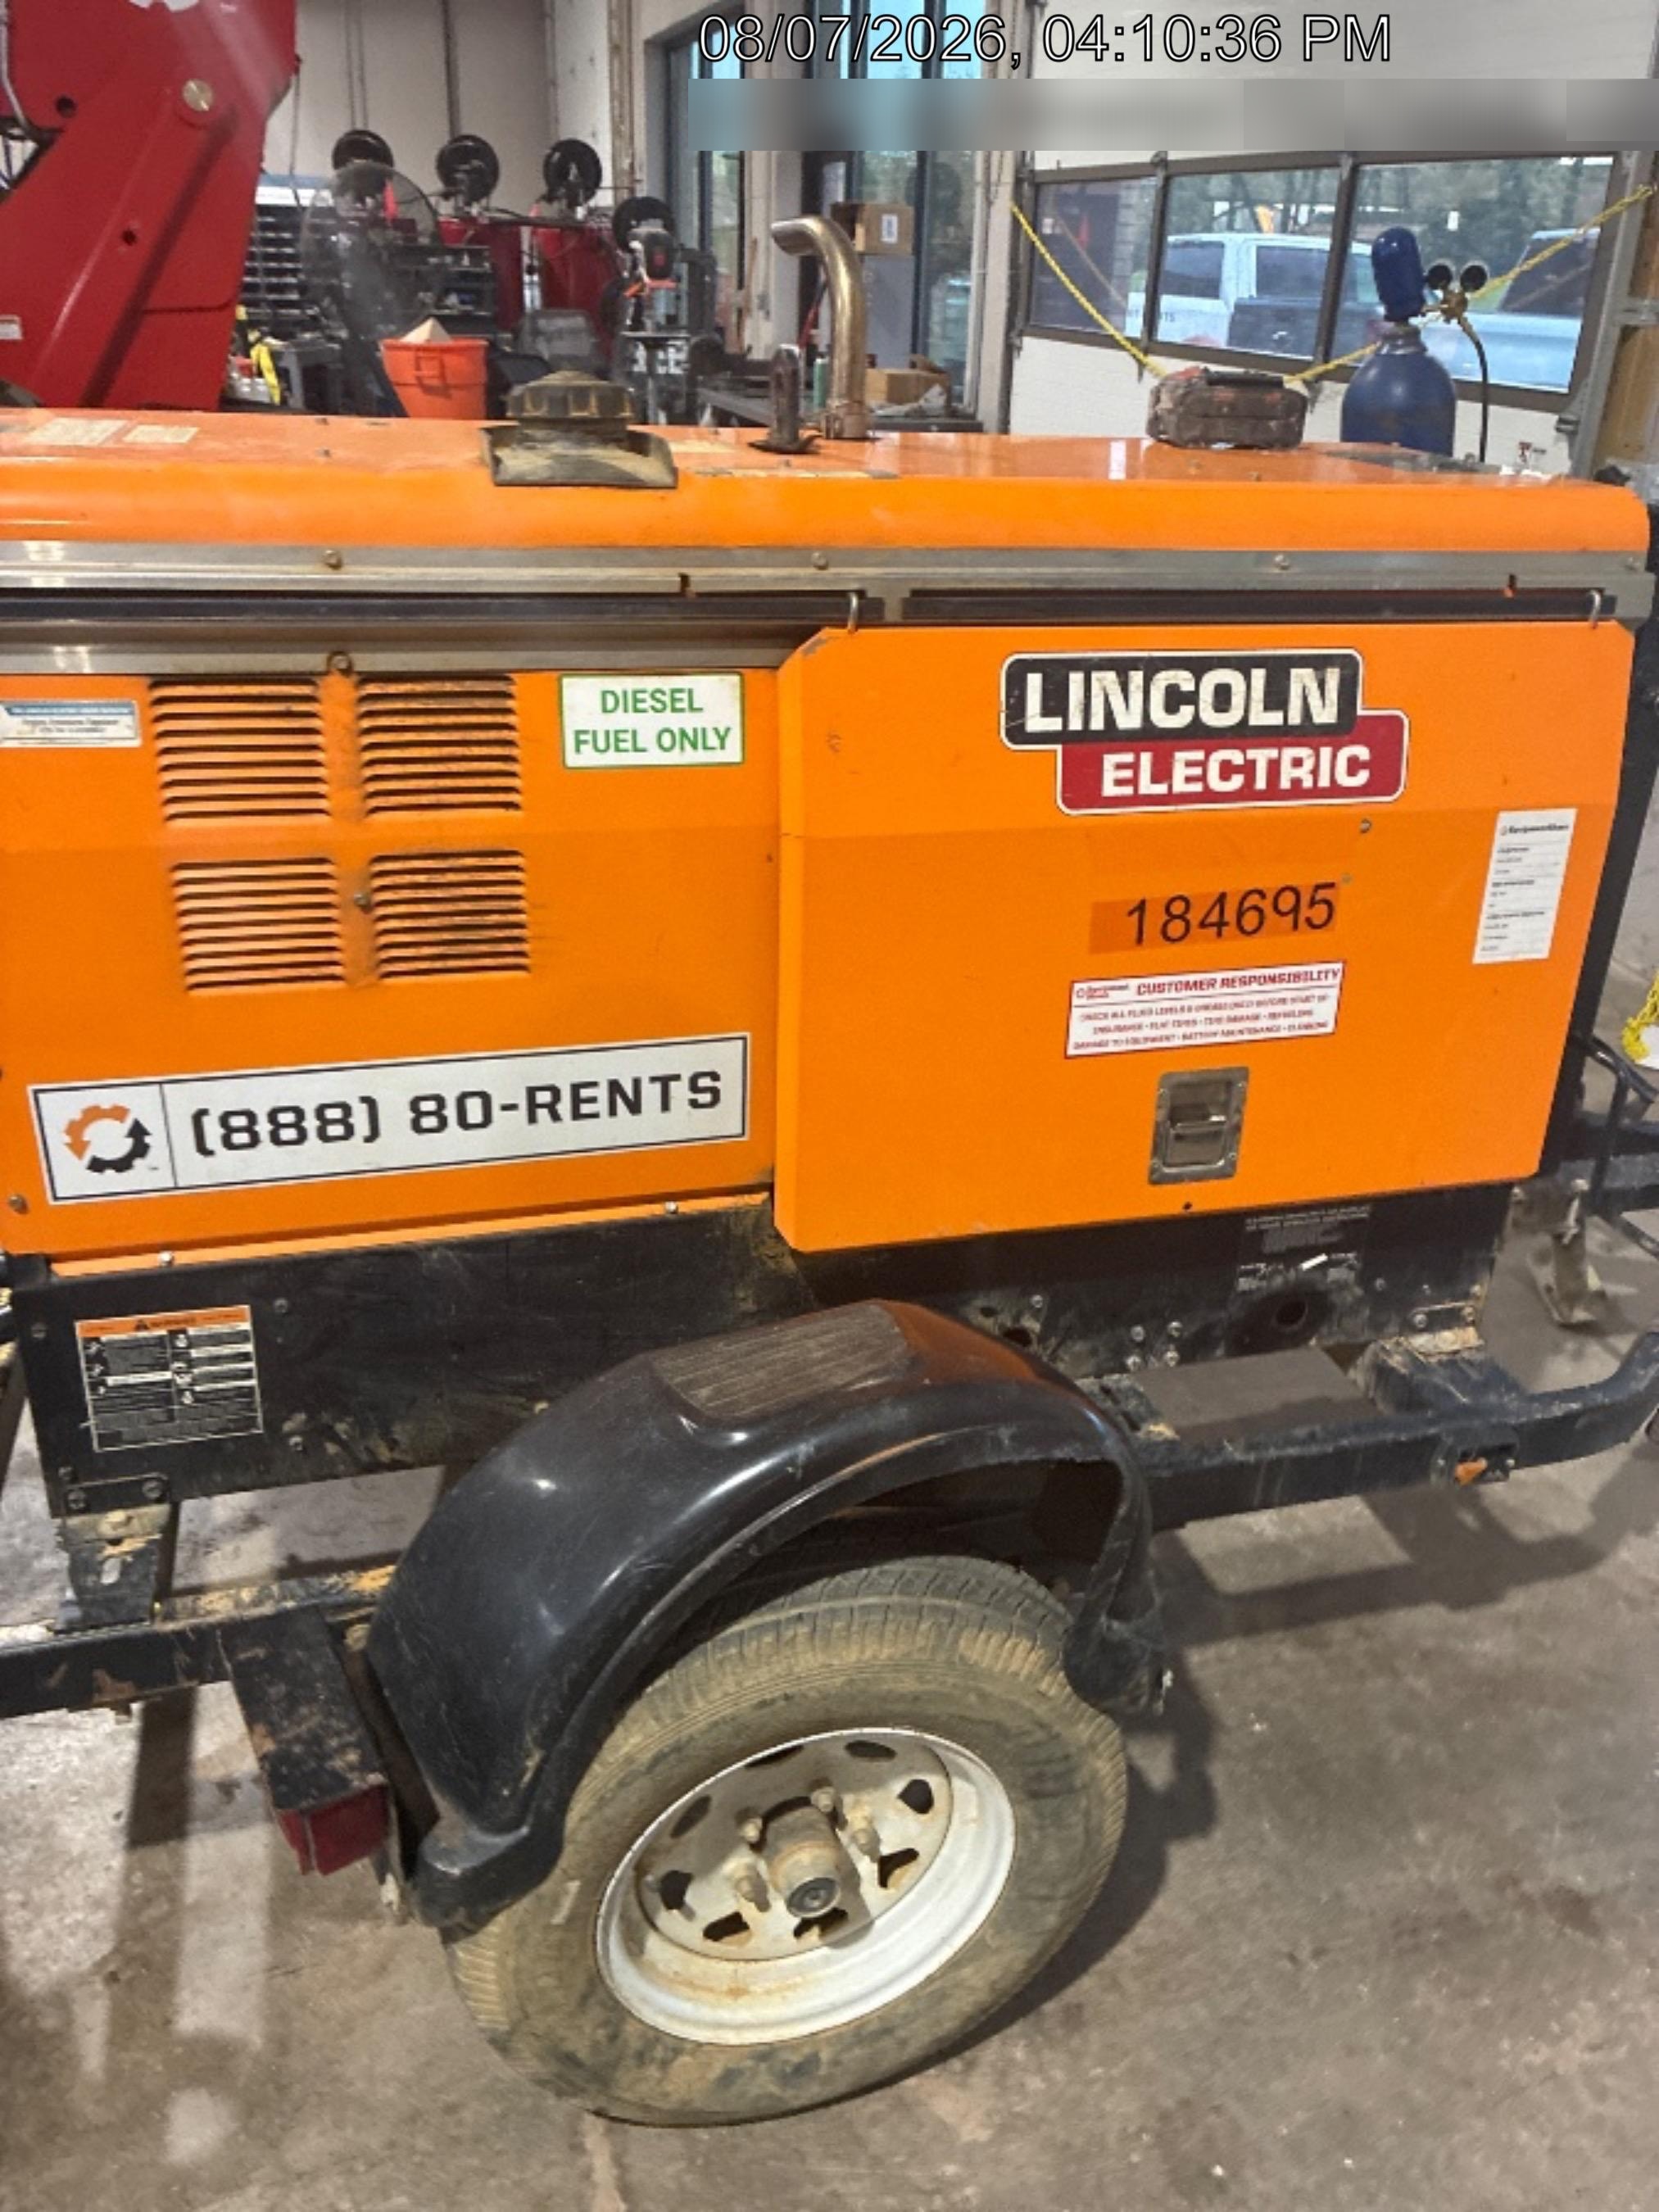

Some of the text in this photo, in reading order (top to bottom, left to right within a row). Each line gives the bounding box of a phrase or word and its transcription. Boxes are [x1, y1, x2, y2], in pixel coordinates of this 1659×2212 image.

[601, 687, 704, 714] DIESEL
[1025, 667, 1340, 732] LINCOLN
[573, 726, 732, 755] FUEL ONLY
[1102, 745, 1371, 797] ELECTRIC
[1126, 882, 1336, 945] 184695
[1136, 977, 1217, 996] CUSTOMER
[1219, 968, 1340, 990] RESPONSIBILITY
[193, 1070, 723, 1158] (888) 80-RENTS
